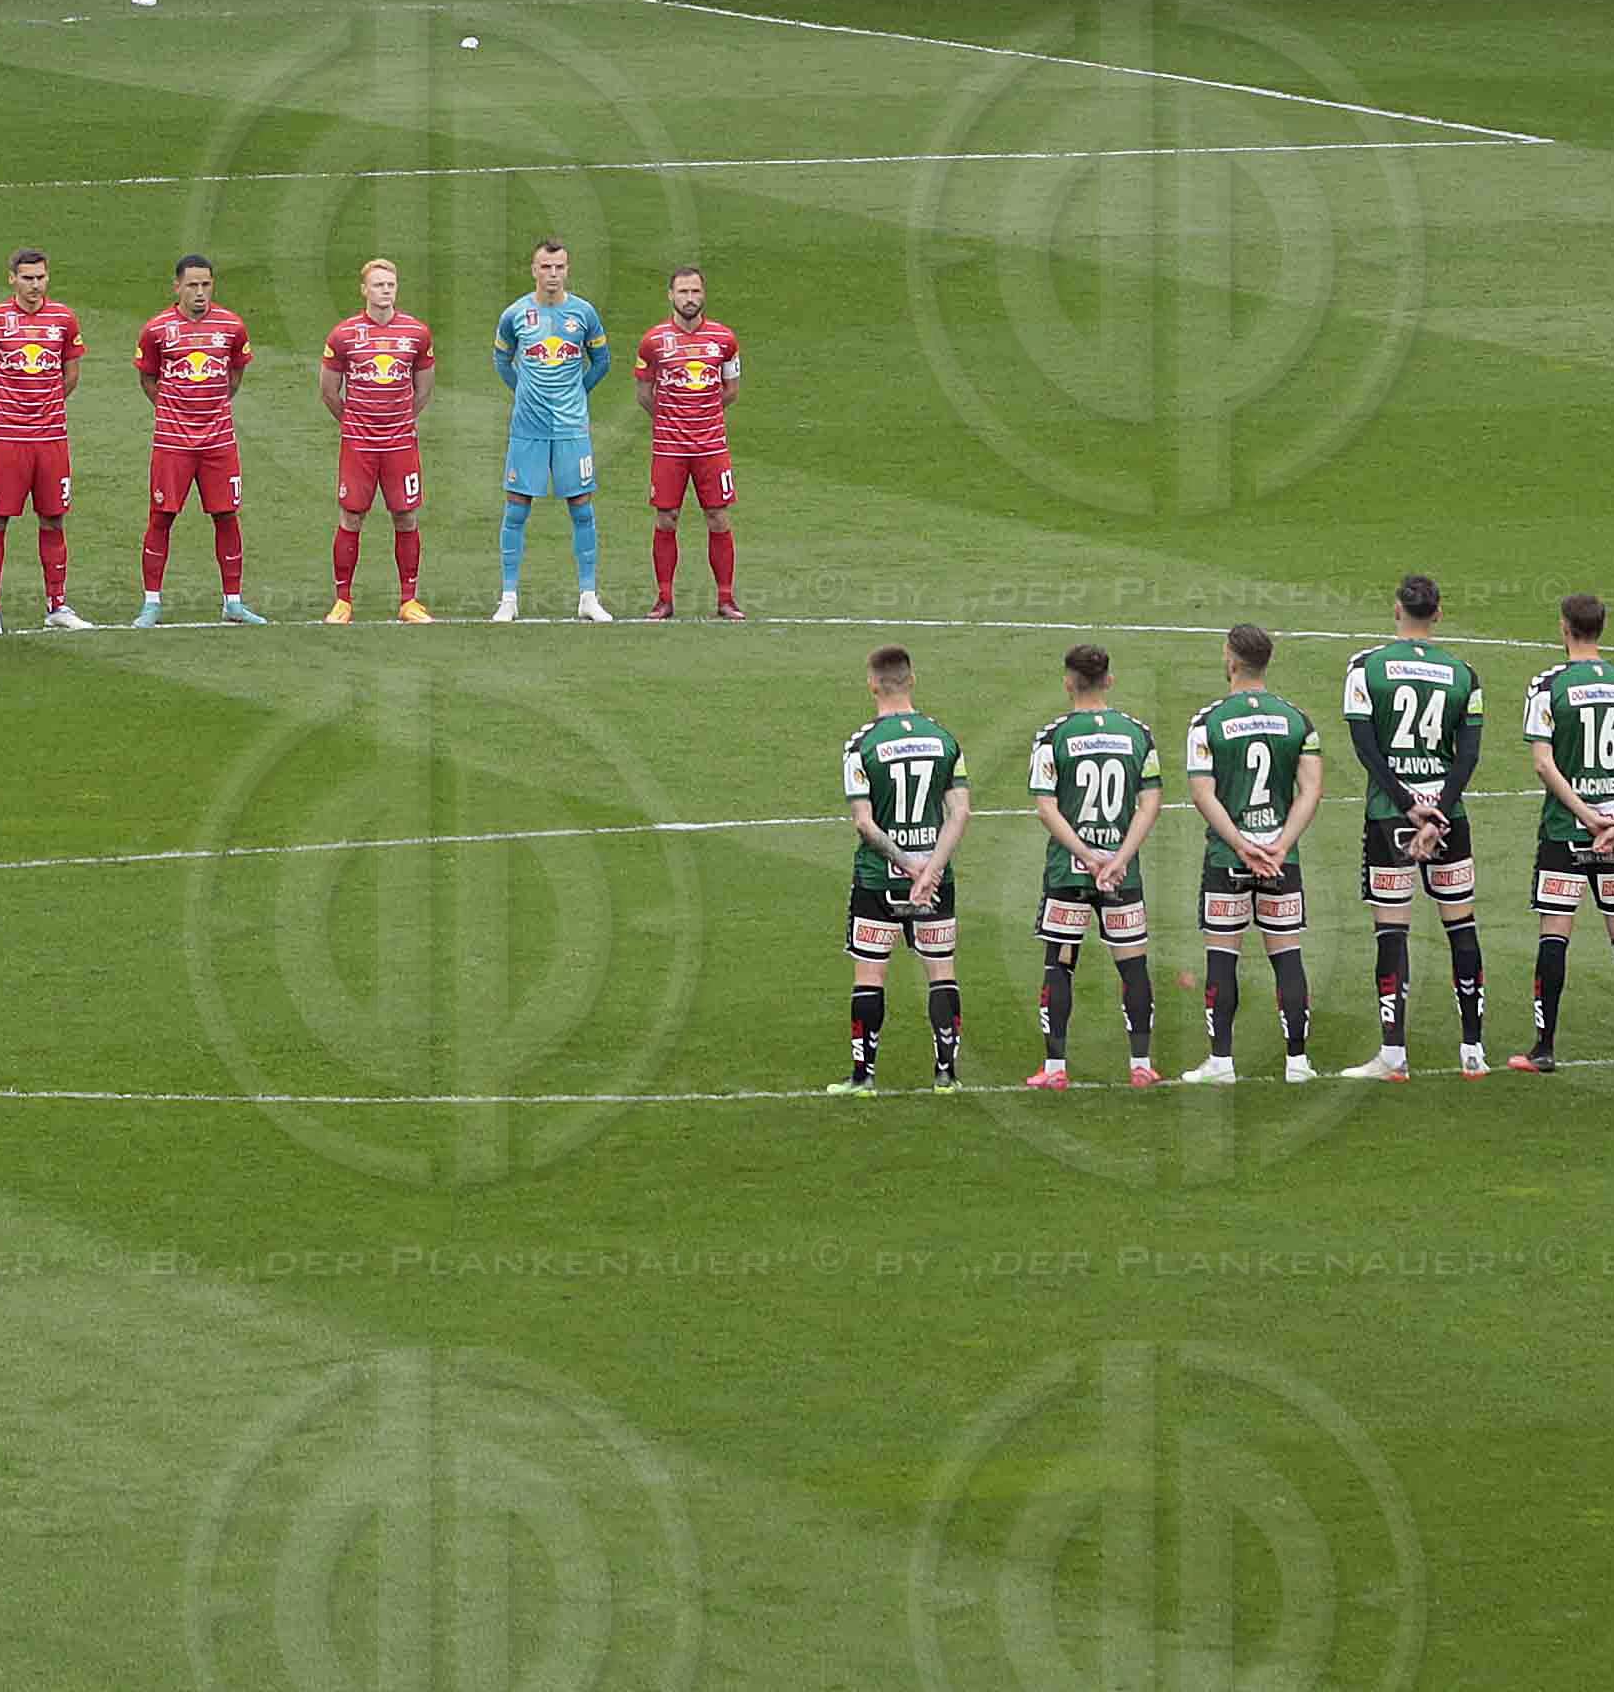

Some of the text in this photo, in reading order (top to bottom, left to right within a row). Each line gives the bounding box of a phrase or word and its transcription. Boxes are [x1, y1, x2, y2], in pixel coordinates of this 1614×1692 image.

[1391, 684, 1447, 751] 24
[889, 760, 935, 824] 17
[1075, 758, 1126, 822] 20
[1246, 740, 1272, 806] 2
